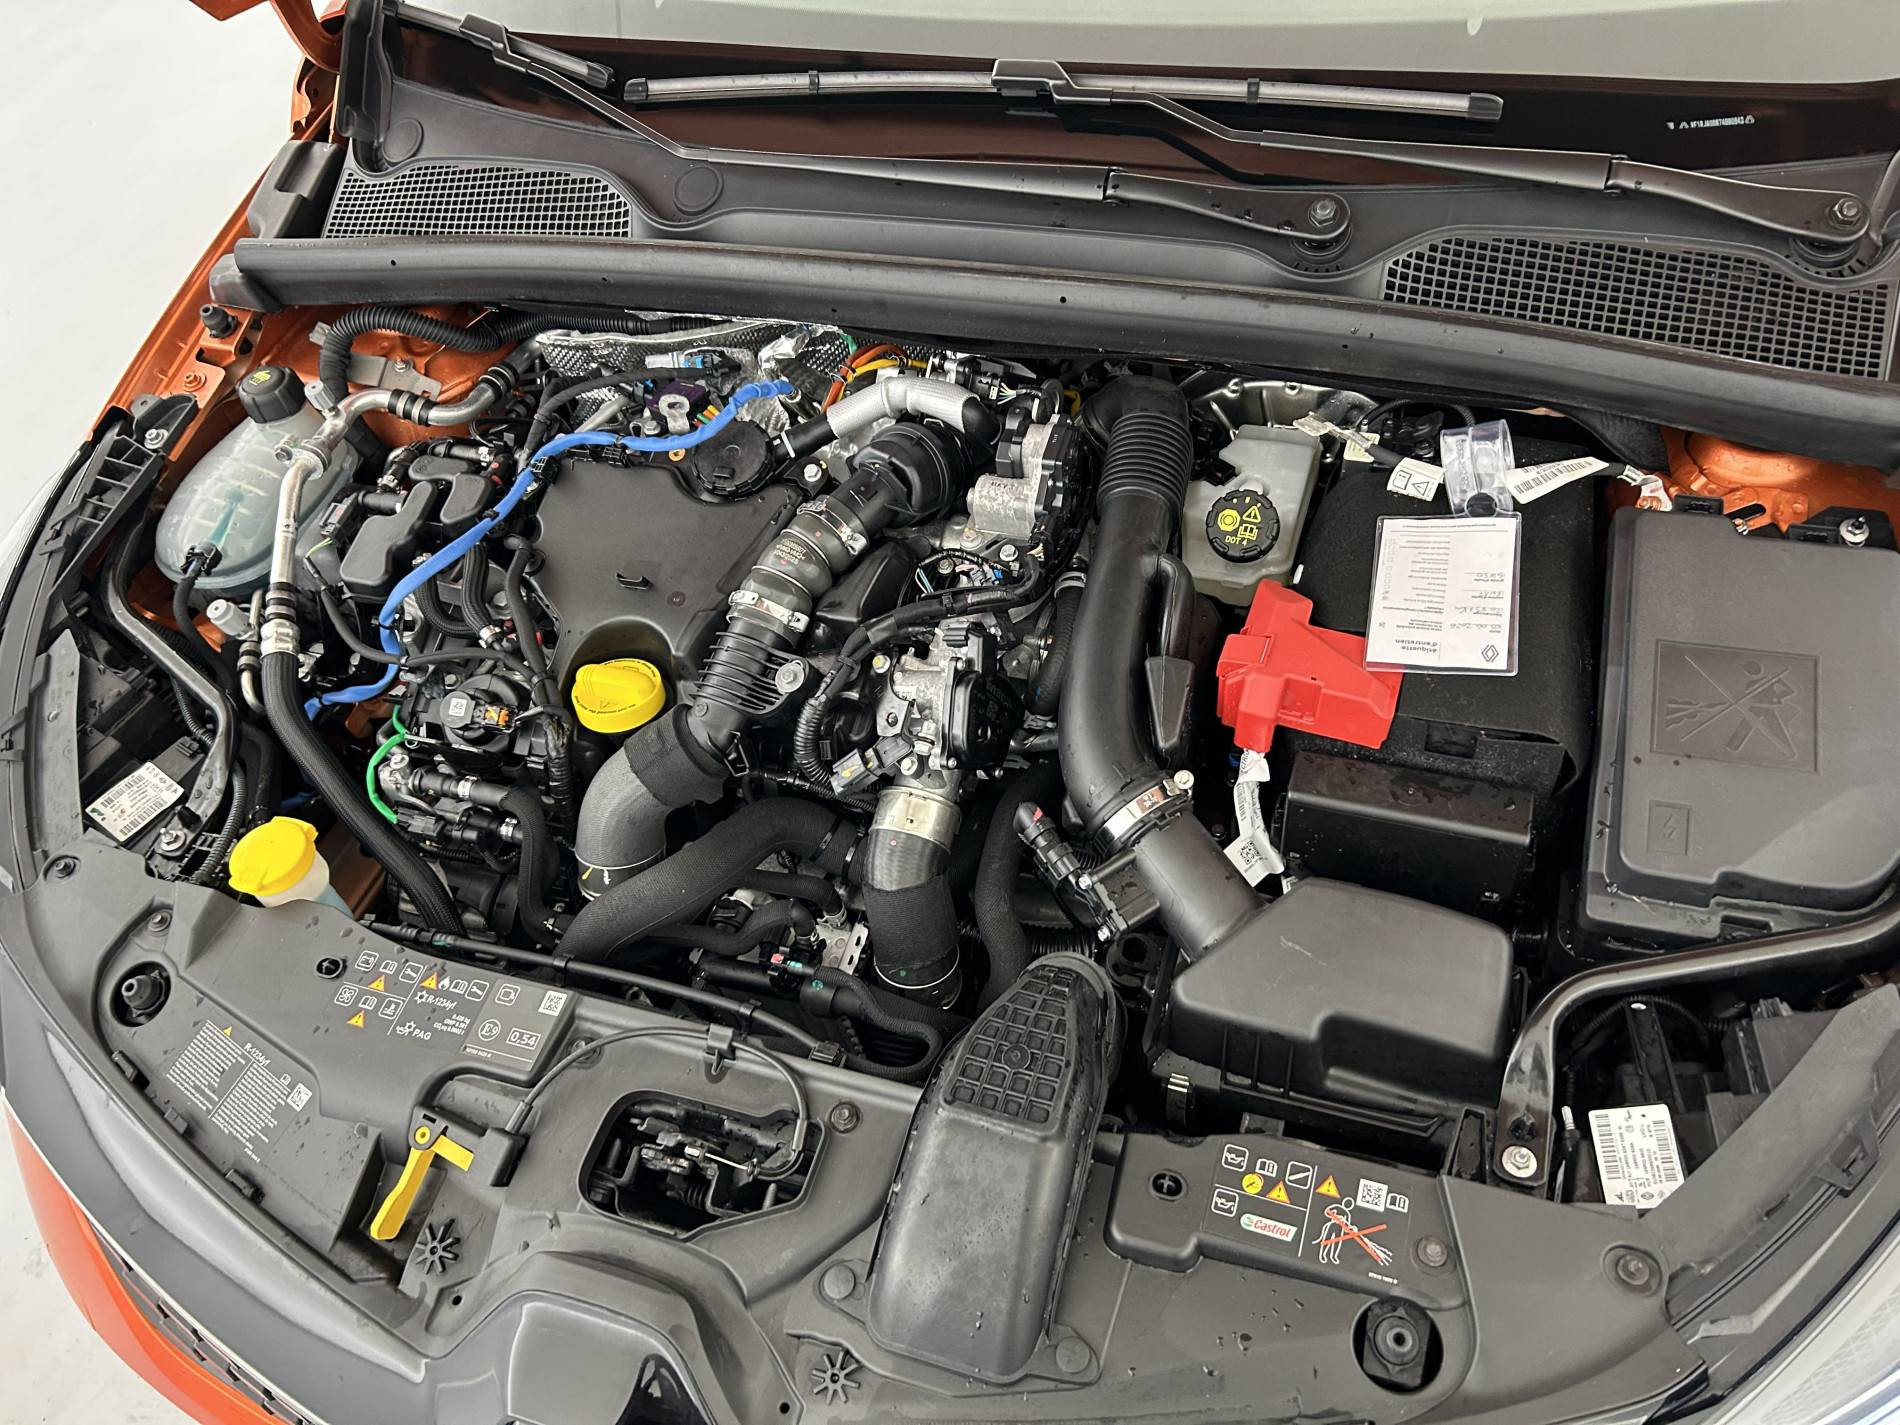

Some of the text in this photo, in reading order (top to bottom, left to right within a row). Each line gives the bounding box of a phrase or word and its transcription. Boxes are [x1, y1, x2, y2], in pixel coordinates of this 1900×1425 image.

[1225, 535, 1248, 546] DOT 4
[412, 1028, 432, 1040] PAG
[510, 1031, 537, 1047] 0,54
[1253, 1219, 1292, 1238] Castrol
